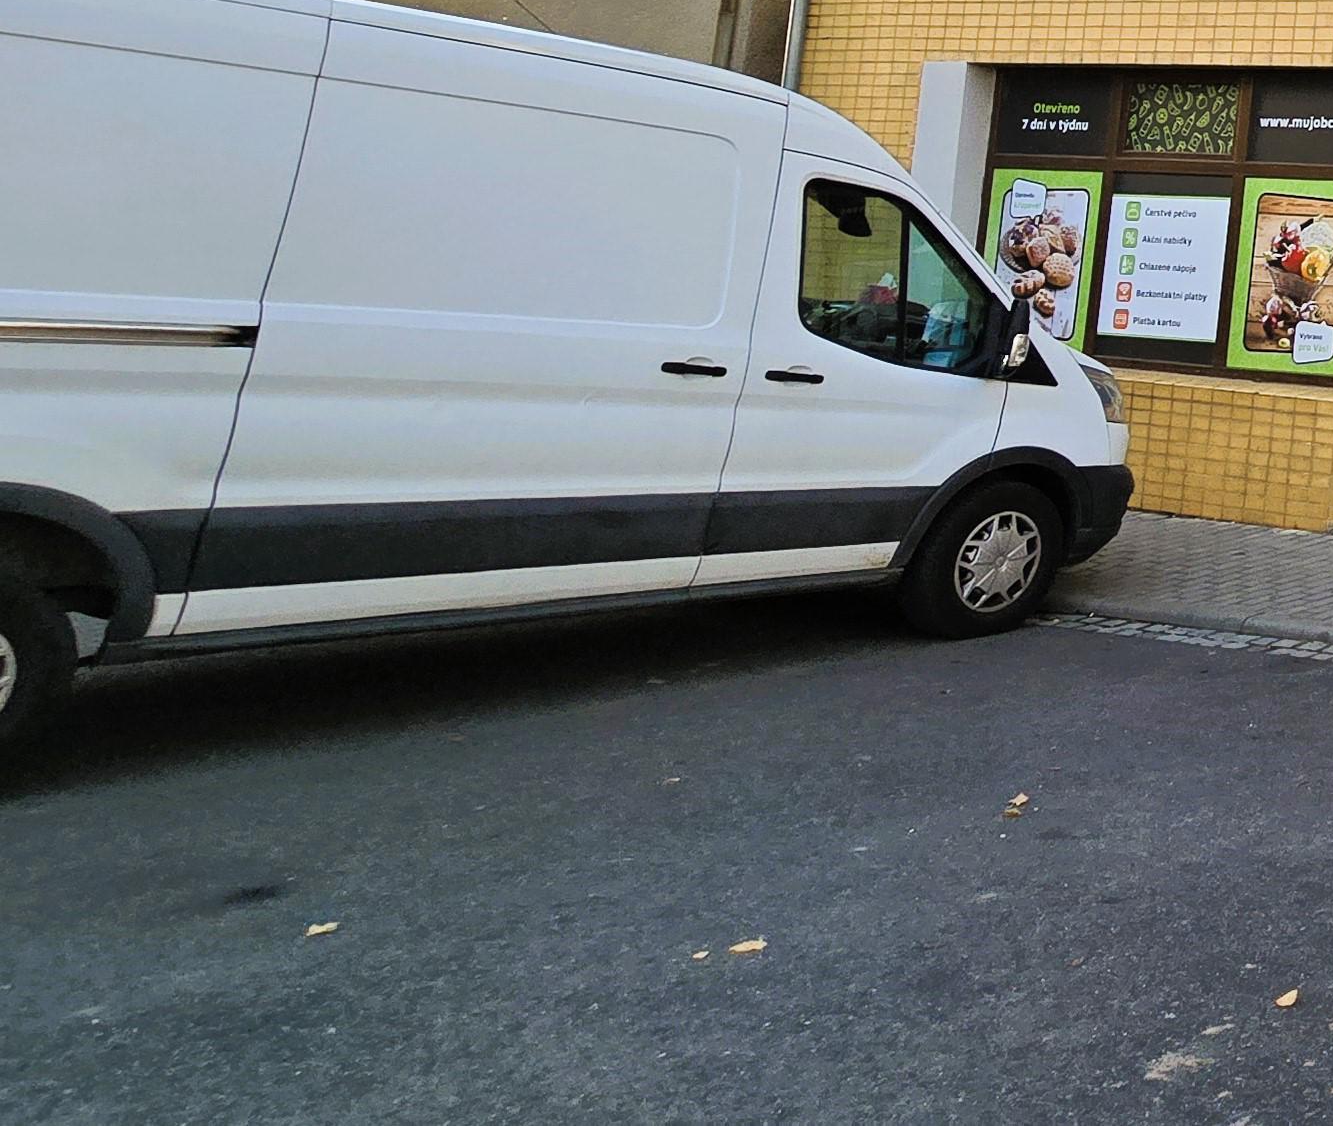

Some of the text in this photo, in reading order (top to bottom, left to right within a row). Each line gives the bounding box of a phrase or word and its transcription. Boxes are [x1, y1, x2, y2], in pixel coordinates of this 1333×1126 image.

[1033, 102, 1081, 114] Otevřeno
[1022, 118, 1089, 133] 7 dní v týdnu
